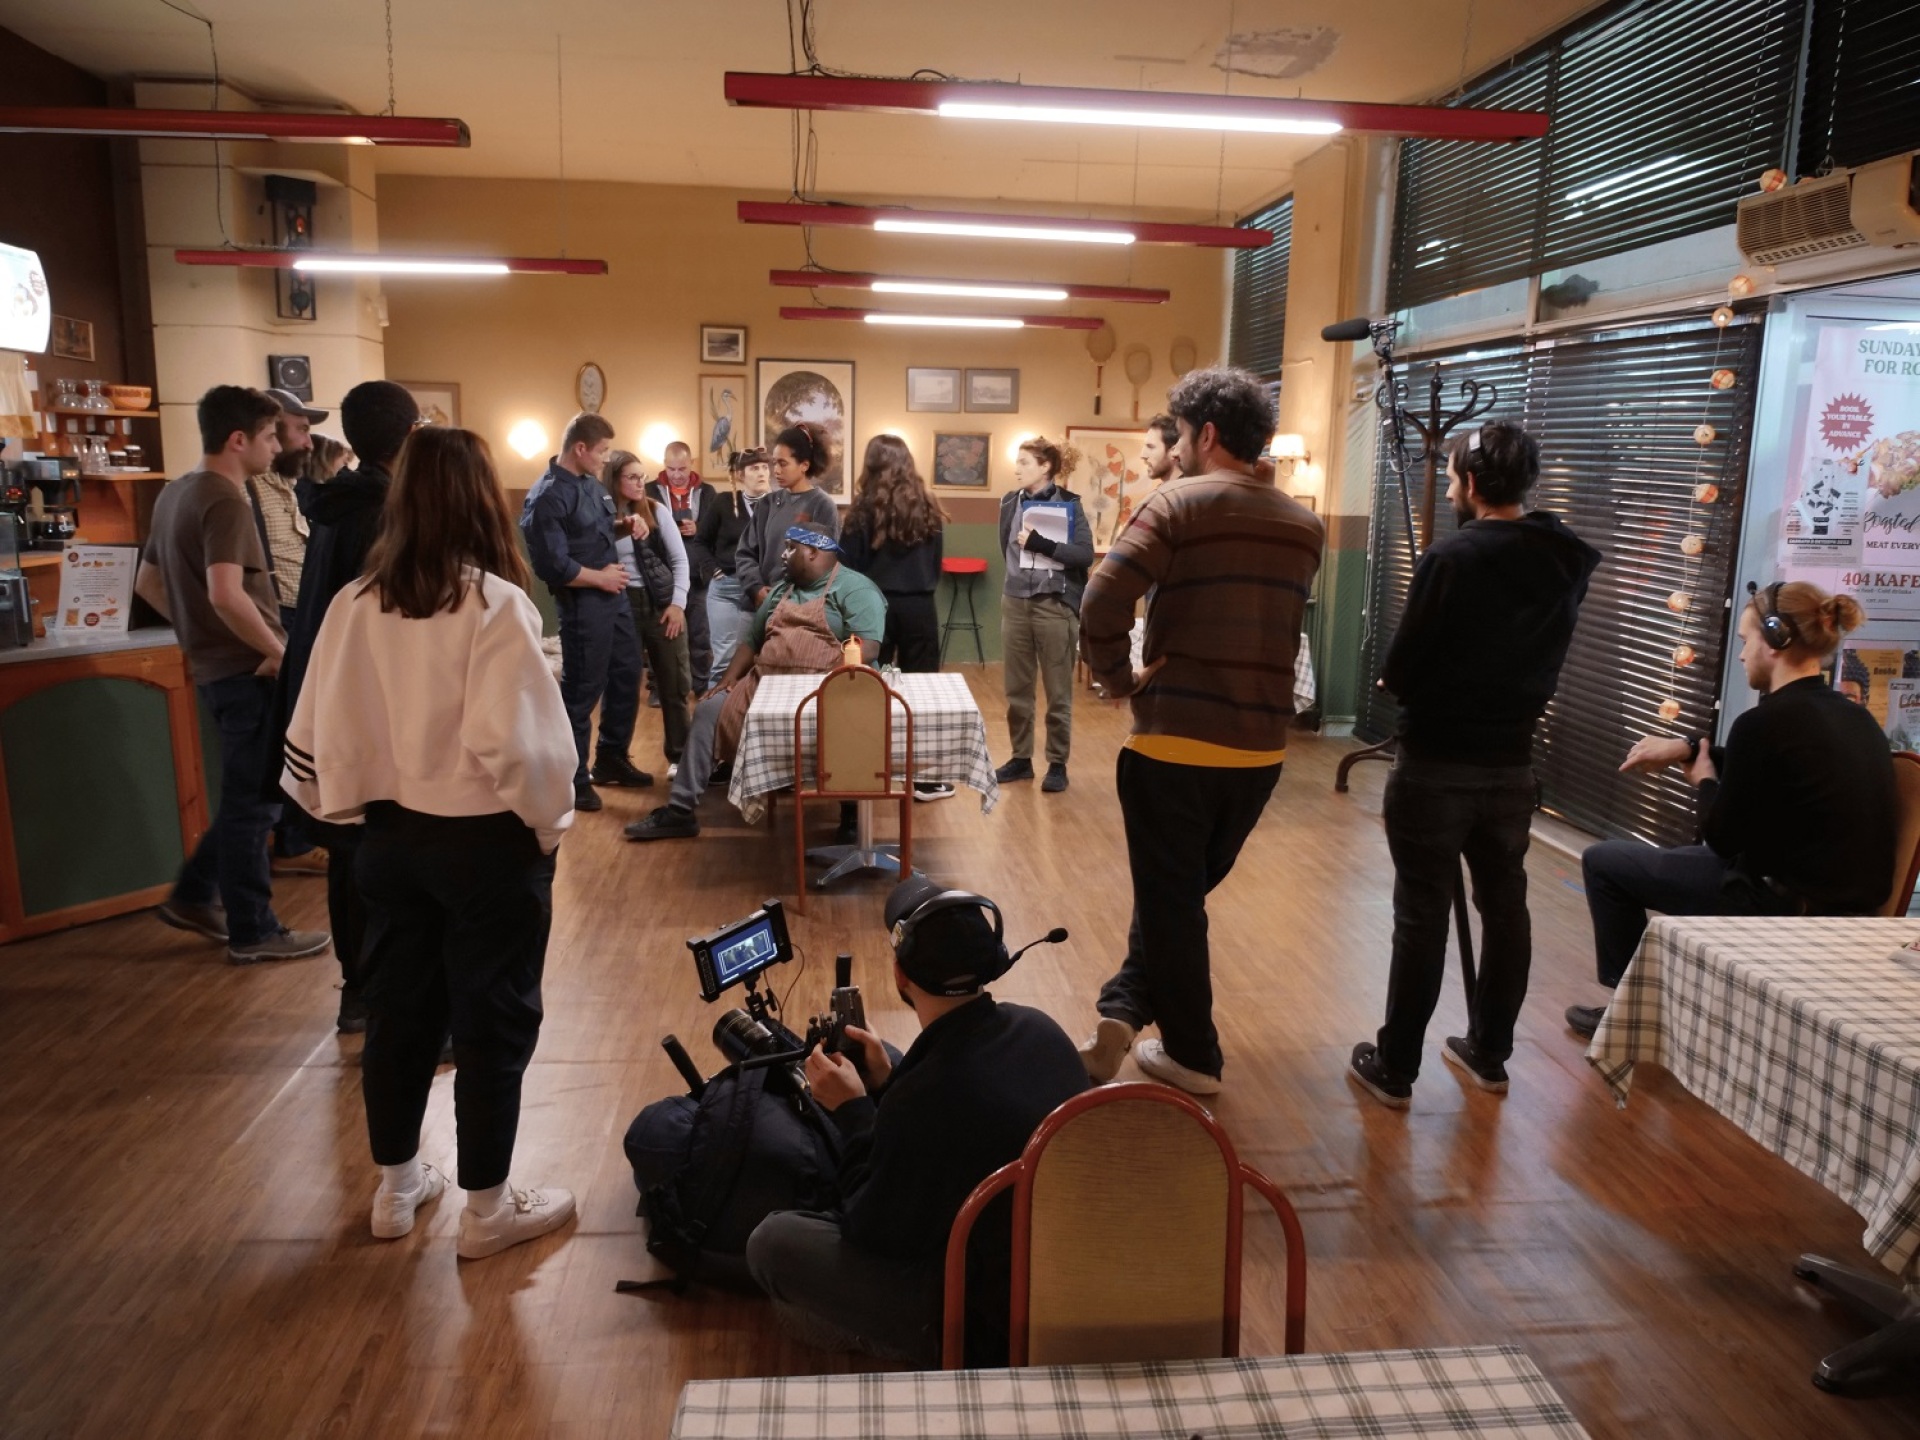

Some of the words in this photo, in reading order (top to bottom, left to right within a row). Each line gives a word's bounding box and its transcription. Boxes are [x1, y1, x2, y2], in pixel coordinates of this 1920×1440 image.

[1864, 359, 1897, 374] FOR
[1828, 430, 1861, 438] ADVANCE
[1863, 511, 1920, 535] Roasted
[1865, 541, 1889, 549] MEAT
[1890, 542, 1920, 550] EVERY
[1842, 572, 1870, 586] 404
[1874, 572, 1920, 588] KAFE
